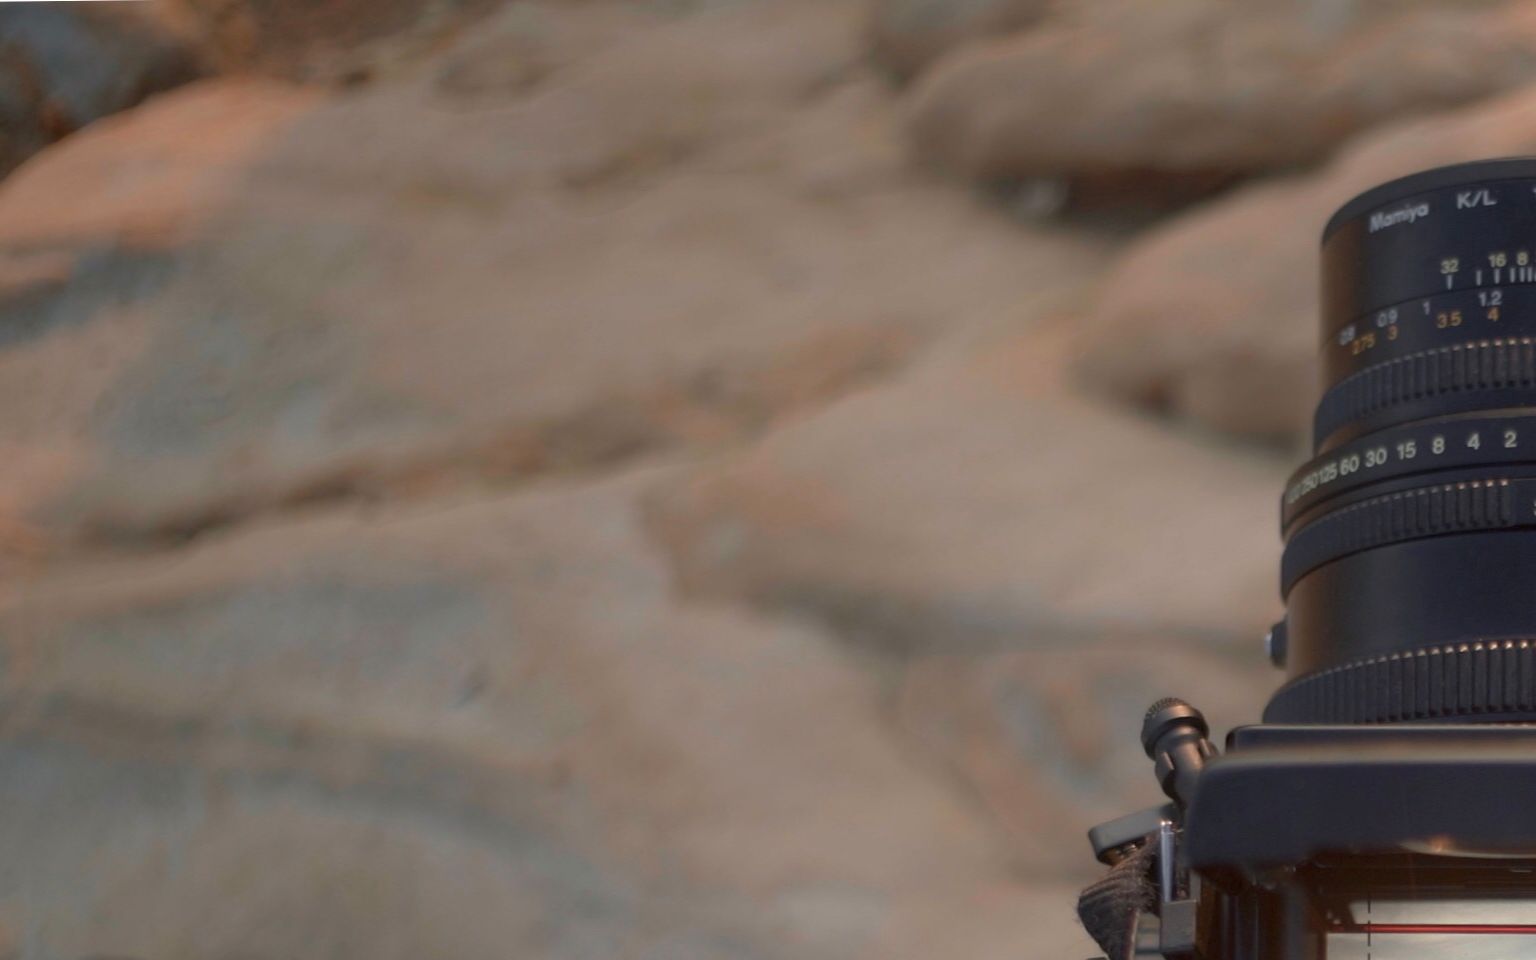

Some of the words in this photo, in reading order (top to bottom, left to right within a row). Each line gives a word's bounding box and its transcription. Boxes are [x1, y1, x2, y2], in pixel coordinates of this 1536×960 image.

[1369, 203, 1430, 234] Mamiya
[1456, 189, 1498, 210] K/L
[1441, 258, 1460, 275] 32
[1488, 253, 1507, 268] 16
[1517, 252, 1529, 266] 8
[1422, 301, 1431, 316] 1
[1478, 290, 1503, 307] 1.2
[1387, 324, 1398, 341] 3
[1486, 306, 1500, 322] 4
[1339, 454, 1361, 476] 60
[1364, 446, 1389, 468] 30
[1396, 441, 1417, 460] 15
[1432, 437, 1446, 454] 8
[1467, 433, 1480, 450] 4
[1504, 431, 1517, 448] 2
